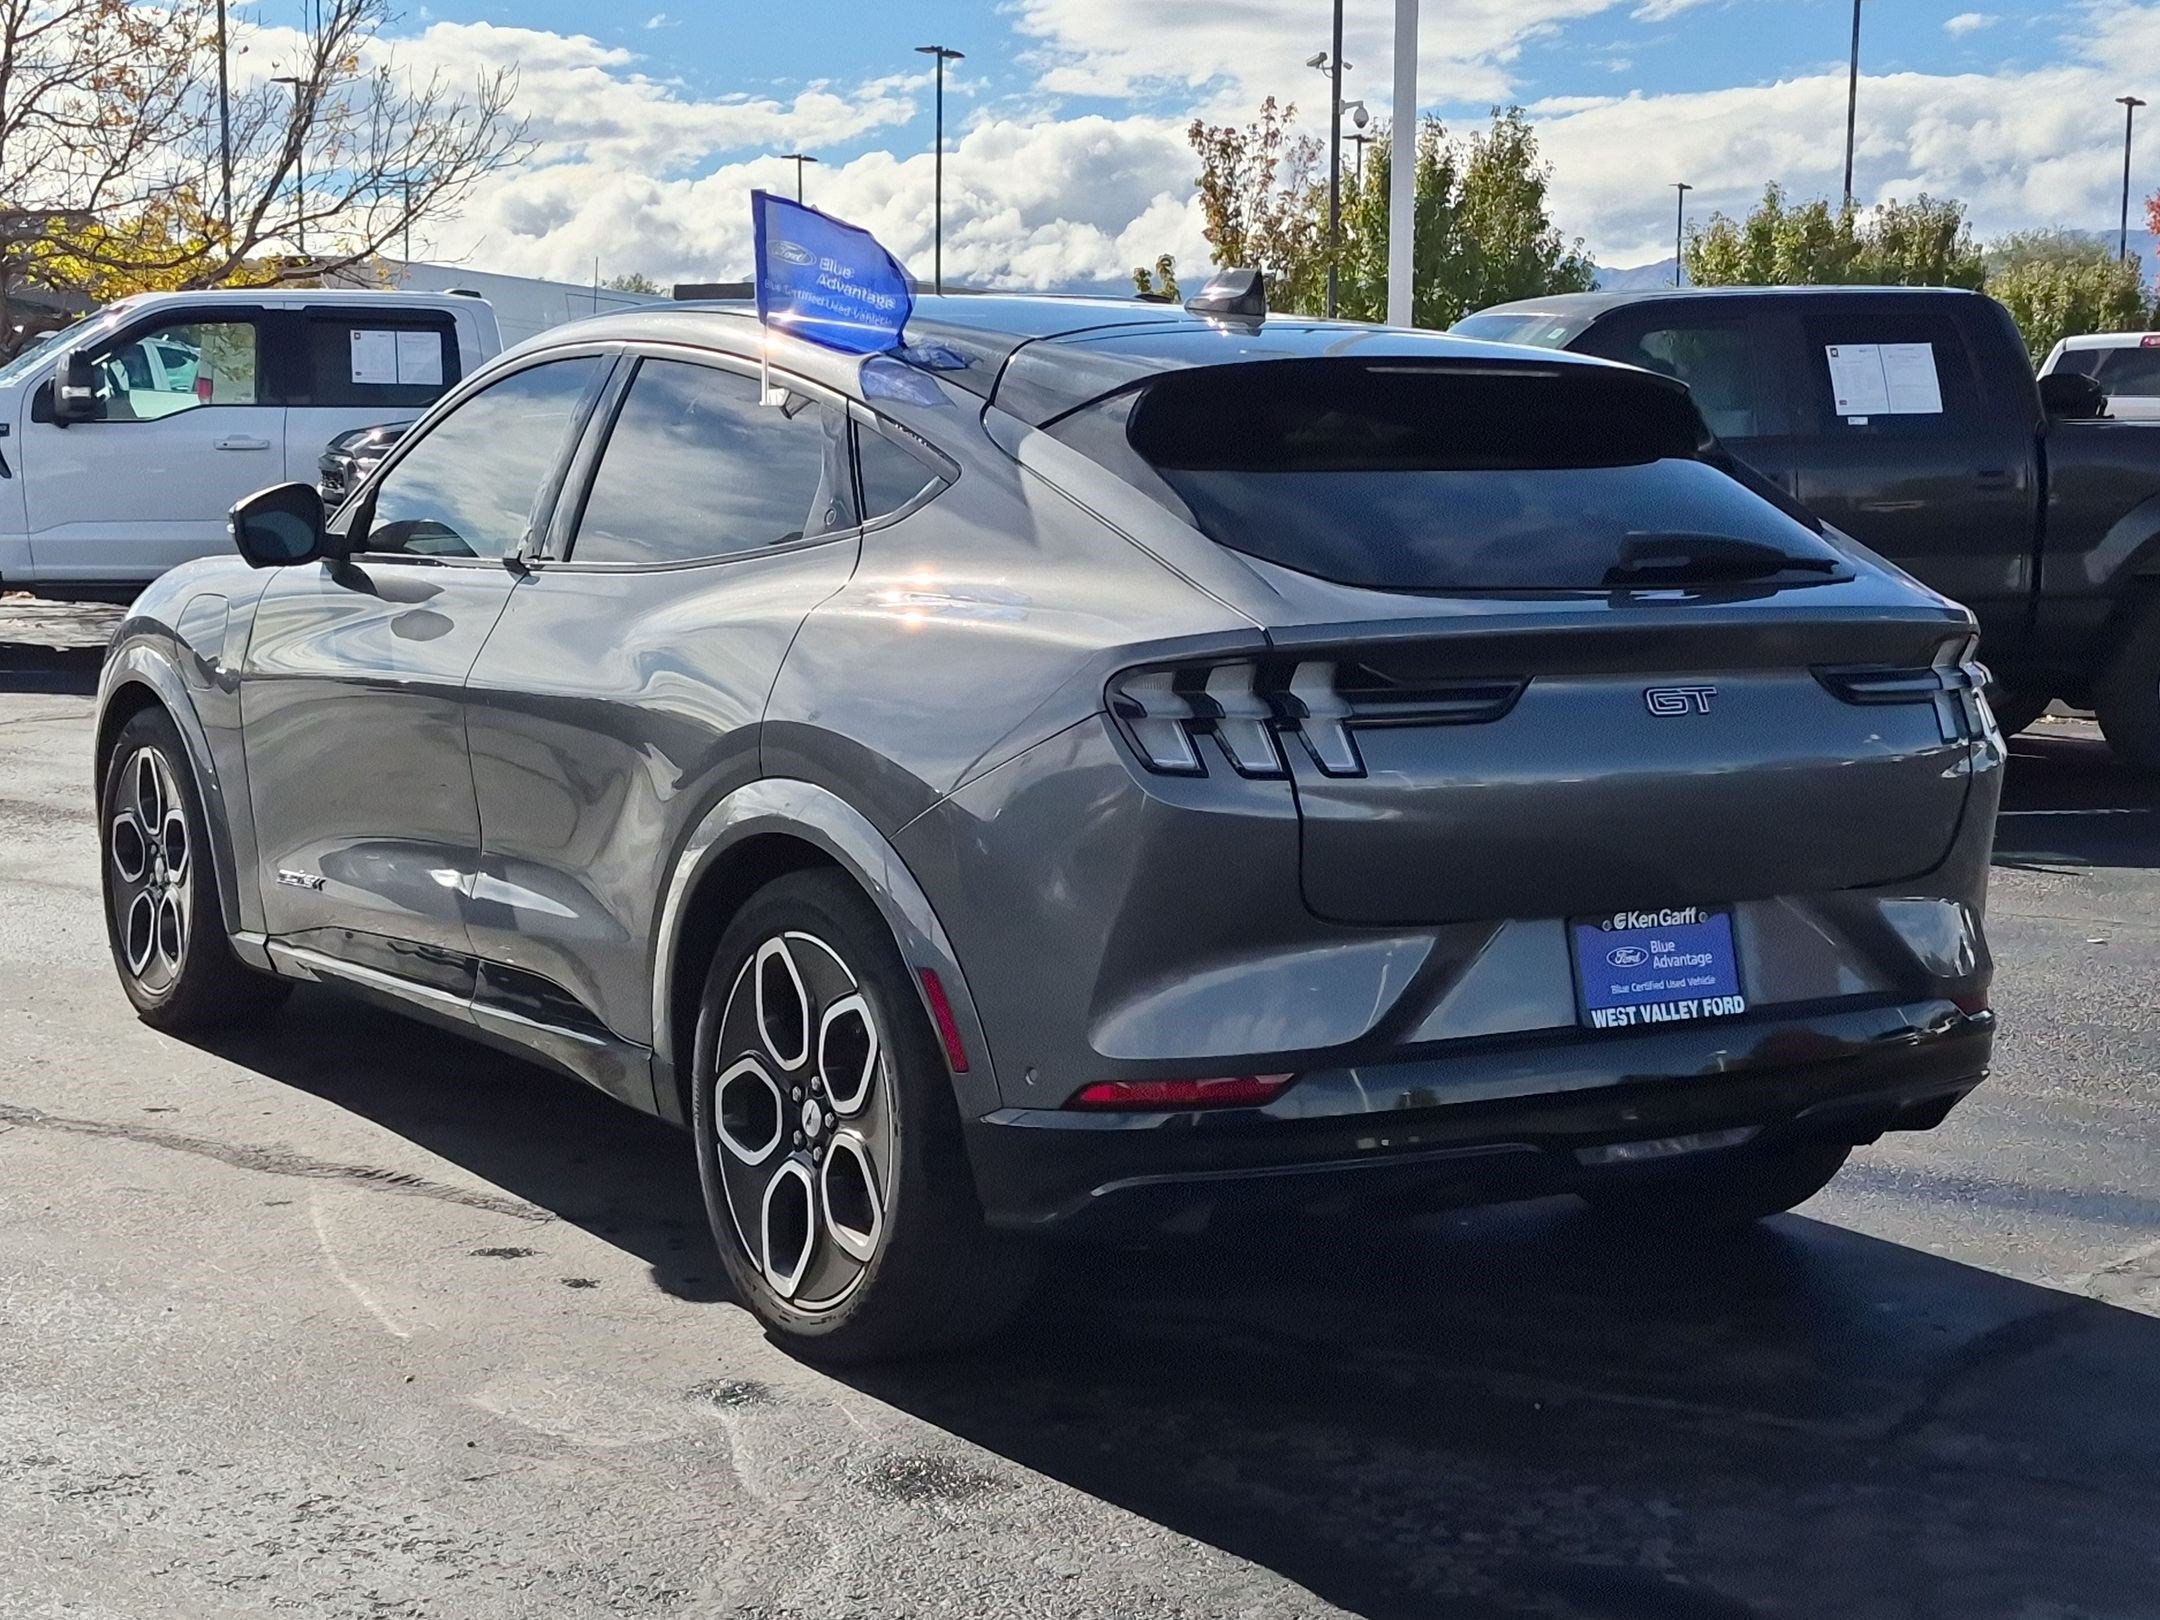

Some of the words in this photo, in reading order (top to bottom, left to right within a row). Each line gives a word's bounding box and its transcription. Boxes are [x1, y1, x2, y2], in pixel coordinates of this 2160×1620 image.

[820, 257, 854, 280] Blue
[816, 272, 897, 311] Advantage
[1645, 686, 1718, 716] GT
[1627, 910, 1657, 929] Ken
[1659, 906, 1697, 926] Garff
[1614, 949, 1641, 965] Ford
[1650, 940, 1675, 954] Blue
[1652, 952, 1713, 970] Advantage
[1610, 984, 1630, 995] Blue
[1631, 980, 1665, 993] Certified
[1666, 978, 1686, 989] Used
[1687, 975, 1716, 987] Vehicle
[1591, 1005, 1637, 1029] WEST
[1640, 1000, 1700, 1024] VALLEY
[1702, 995, 1746, 1017] FORD
